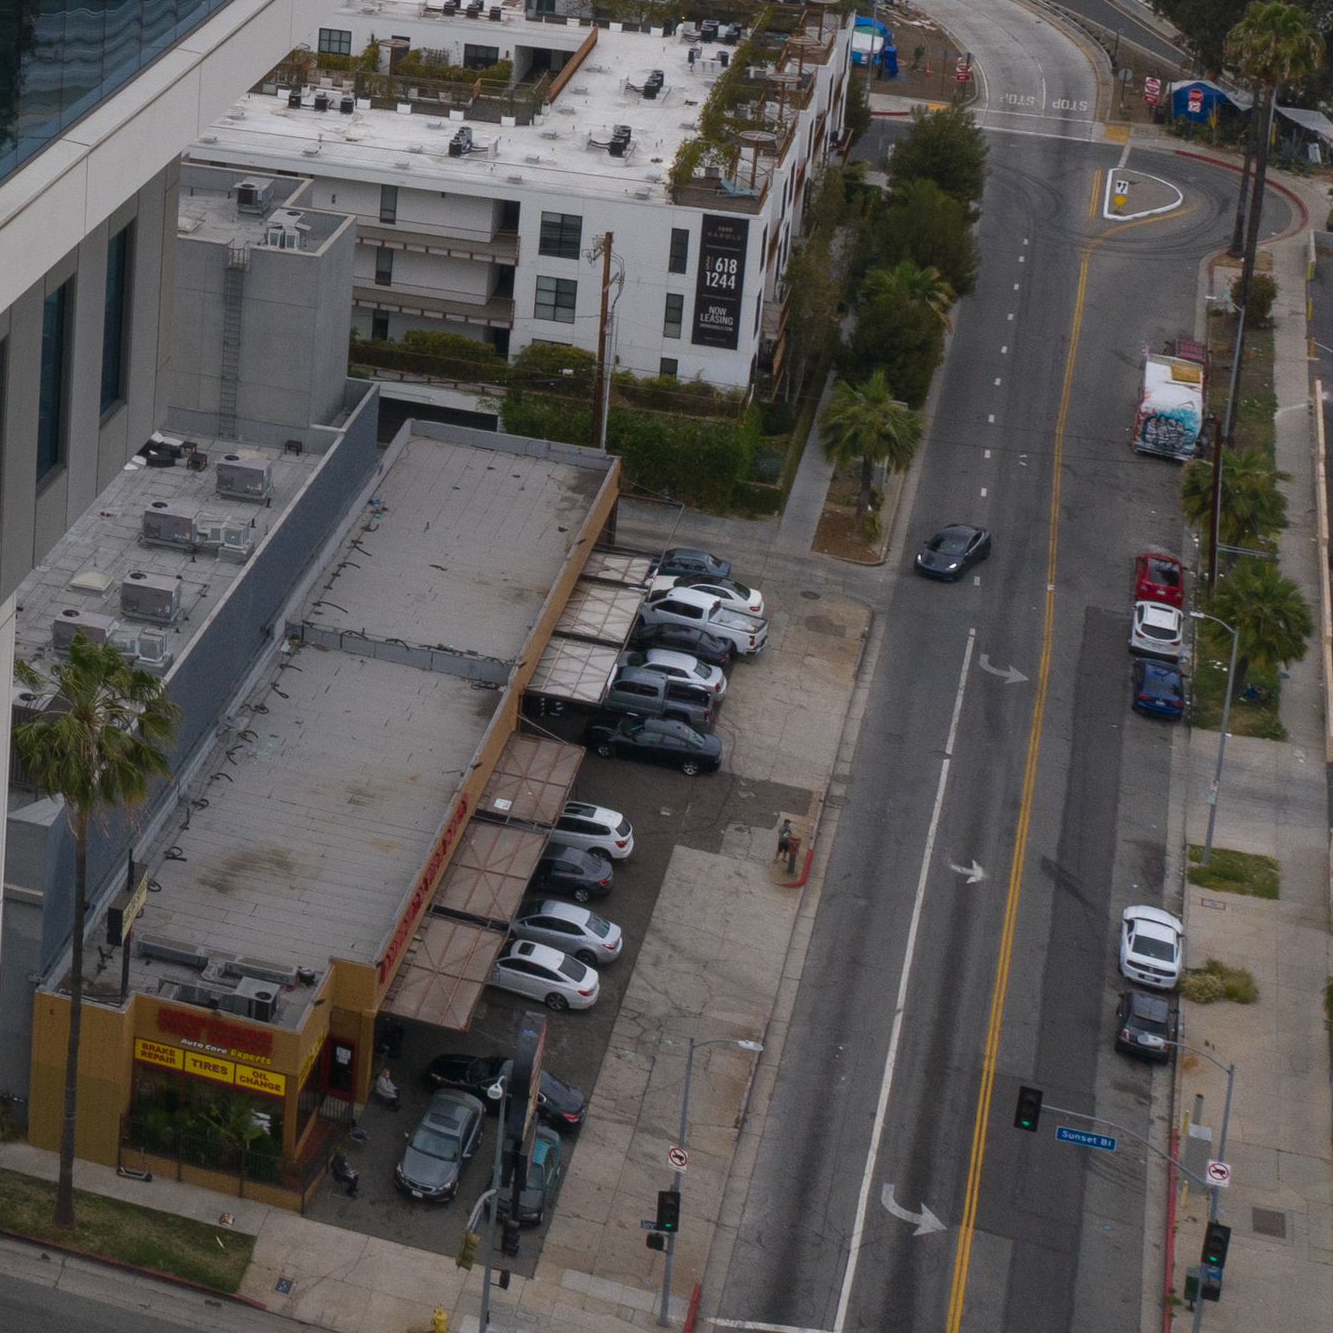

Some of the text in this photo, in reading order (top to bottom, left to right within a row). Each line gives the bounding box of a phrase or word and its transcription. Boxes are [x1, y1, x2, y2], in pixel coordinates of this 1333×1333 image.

[1051, 98, 1088, 111] STOP
[715, 257, 738, 274] 618
[705, 271, 736, 290] 1244
[708, 306, 727, 316] NOW
[700, 313, 734, 326] LEASING
[140, 1049, 176, 1065] REPAIR
[142, 1043, 175, 1057] BRAKE
[181, 1038, 273, 1066] Auto Care Experts
[190, 1057, 229, 1076] TIRES
[238, 1075, 282, 1092] CHANGE
[252, 1070, 269, 1081] OIL
[1062, 1129, 1111, 1147] Sunset Bl
